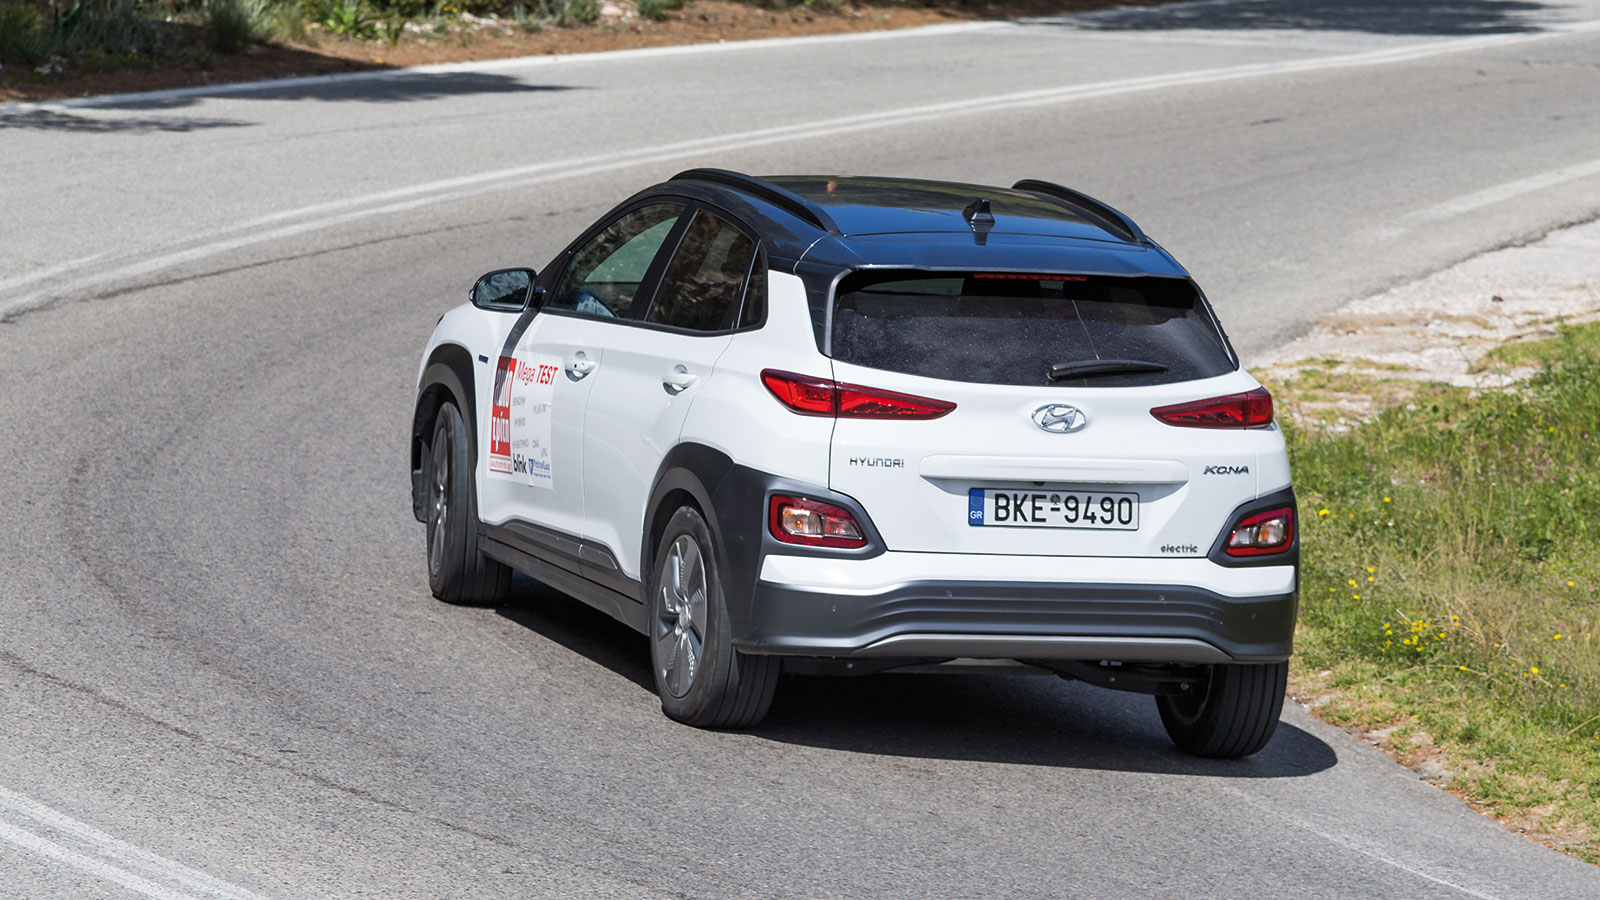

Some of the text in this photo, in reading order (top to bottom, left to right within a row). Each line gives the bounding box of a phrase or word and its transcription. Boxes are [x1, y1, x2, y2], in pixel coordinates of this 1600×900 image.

[516, 361, 559, 386] Mega TEST
[513, 453, 528, 474] blink
[849, 457, 905, 468] HYUNDAI
[1203, 465, 1250, 476] KONA
[970, 510, 983, 520] GR
[994, 493, 1133, 526] BKE-9490
[1160, 543, 1199, 554] electric
